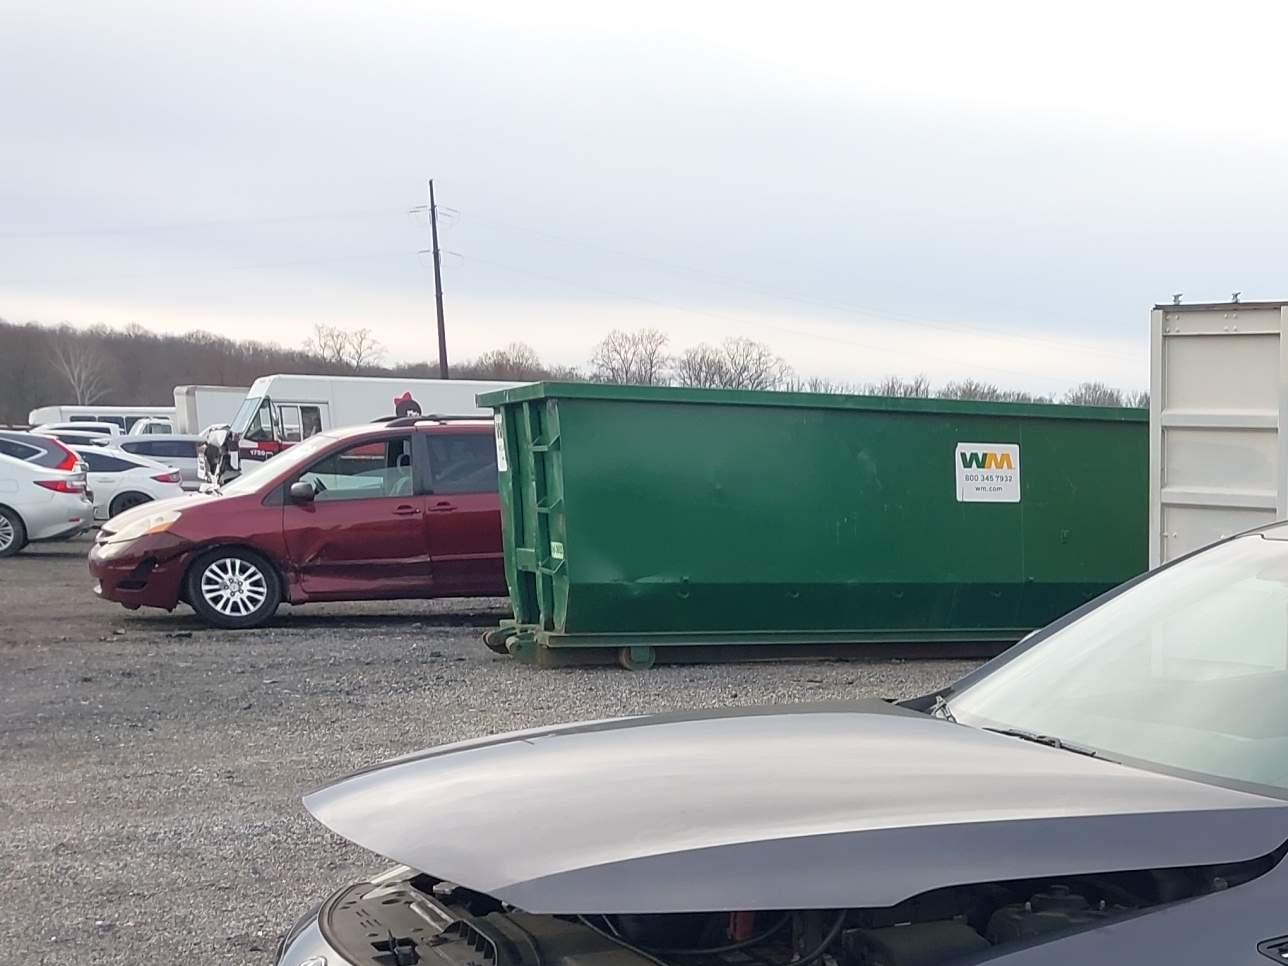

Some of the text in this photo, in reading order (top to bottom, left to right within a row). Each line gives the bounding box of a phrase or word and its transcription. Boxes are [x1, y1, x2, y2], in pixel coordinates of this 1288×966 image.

[960, 451, 1013, 470] WM
[965, 474, 979, 482] 800
[980, 474, 994, 482] 345
